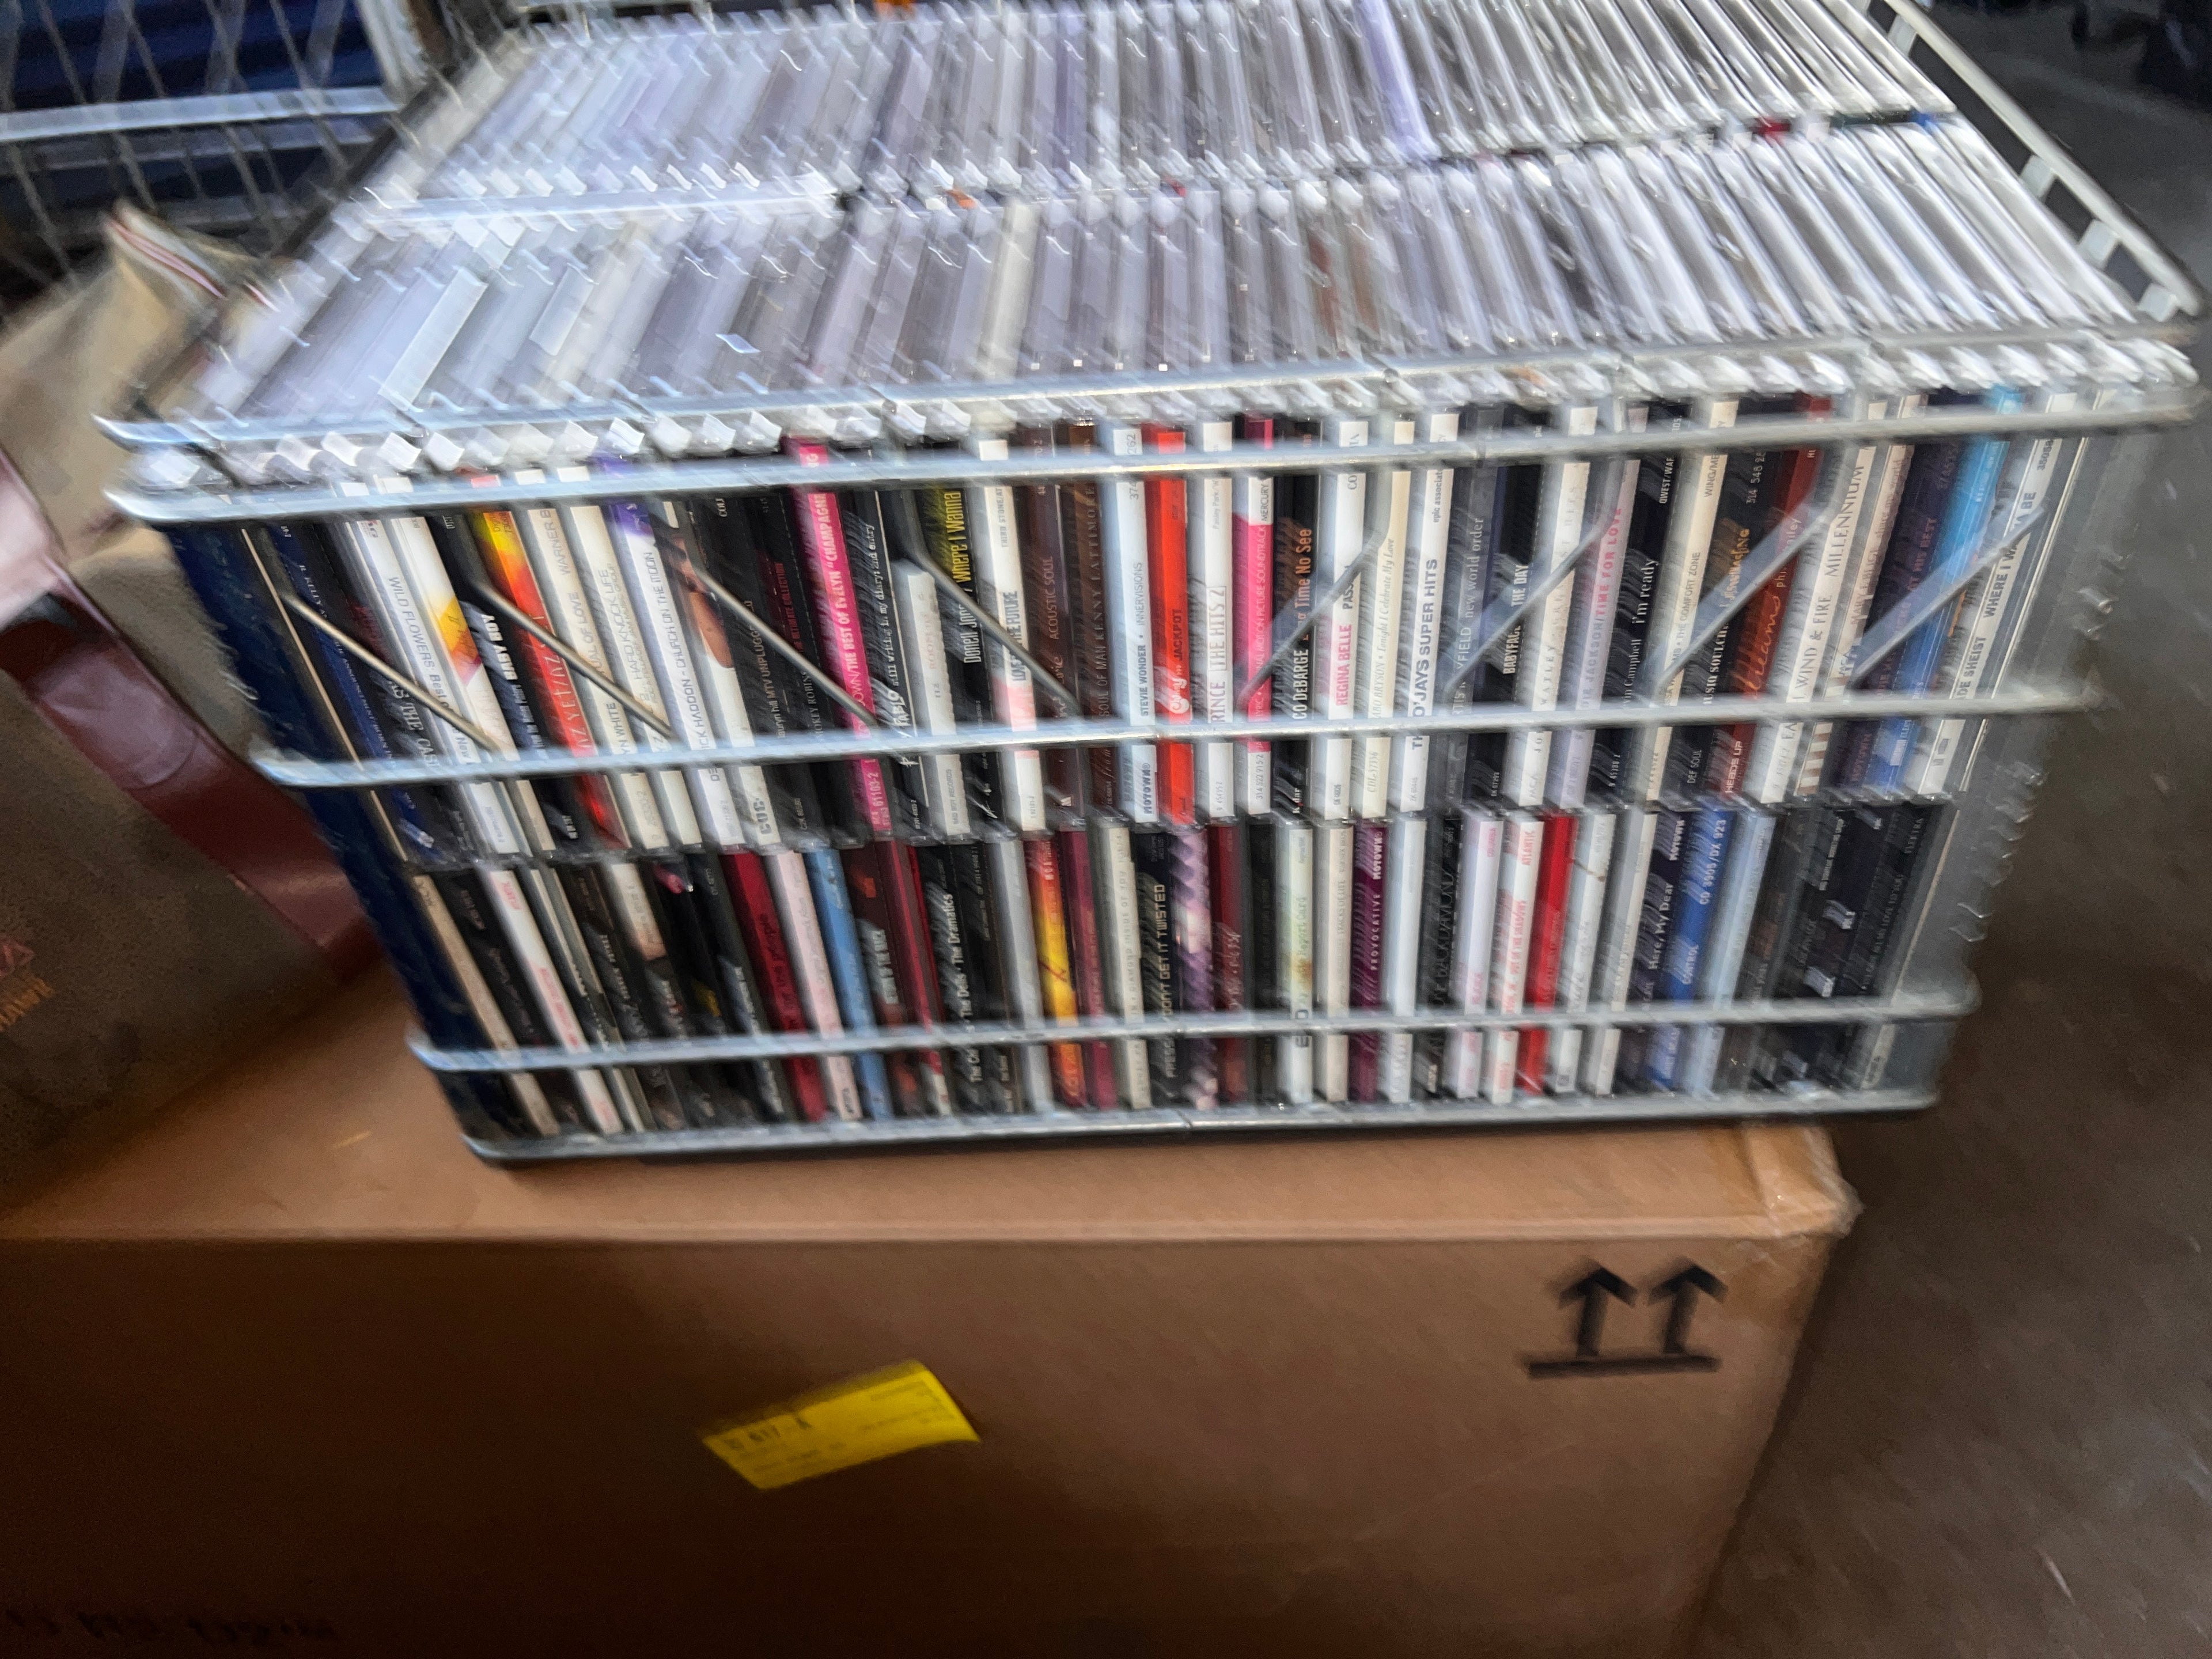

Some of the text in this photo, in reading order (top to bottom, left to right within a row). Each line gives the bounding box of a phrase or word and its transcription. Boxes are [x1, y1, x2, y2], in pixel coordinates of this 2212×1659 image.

[944, 491, 964, 533] Wanna
[1260, 484, 1270, 522] MERCURY
[1432, 507, 1442, 523] epic
[545, 522, 570, 576] WARNER
[865, 524, 877, 550] entry
[1256, 525, 1267, 584] SOUNDTRACK
[1382, 538, 1395, 558] Love
[1601, 508, 1623, 578] FOR LOVE
[643, 552, 662, 584] MOON
[869, 552, 880, 569] 2nd
[951, 544, 971, 582] Where
[1294, 529, 1312, 609] Time No See
[1381, 560, 1395, 574] My
[1423, 559, 1438, 597] HITS
[1463, 517, 1484, 618] new world order
[1513, 565, 1530, 584] DAY
[1685, 552, 1700, 576] ZONE
[1797, 465, 1865, 688] WIND & FIRE MILLENNIUM
[652, 586, 666, 605] THE
[1041, 555, 1060, 639] ACOUSTIC SOUL
[1209, 589, 1224, 597] 2
[1256, 585, 1266, 617] PICTURE
[1378, 575, 1392, 614] Celebrate
[1510, 588, 1527, 607] THE
[1677, 579, 1695, 622] COMFORT
[1964, 636, 1987, 677] SHEIST
[1983, 573, 2009, 618] WHERE
[2020, 491, 2036, 510] BE
[569, 591, 588, 623] LOVE
[598, 569, 643, 680] HARD KNOCK LIFE
[660, 609, 672, 623] ON
[828, 571, 855, 650] BEST OF EVELYN
[877, 603, 888, 614] my
[1002, 591, 1018, 626] FUTURE
[1209, 603, 1225, 637] HITS
[1623, 558, 1659, 687] Campbell i'm ready
[388, 577, 446, 697] WILD Best
[1132, 562, 1150, 717] STEVIE WONDER INNERVISIONS
[1172, 609, 1183, 661] JACKPOT
[1255, 618, 1266, 652] MOTION
[1376, 622, 1389, 652] Tonight
[1419, 602, 1434, 655] SUPER
[482, 615, 518, 680] BABY BOY
[664, 626, 687, 668] CHURCH
[960, 631, 982, 663] Donell
[1094, 645, 1108, 670] MAN
[1209, 641, 1226, 667] THE
[1335, 624, 1353, 706] REGINA BELLE
[764, 680, 778, 699] MTV
[1095, 674, 1108, 687] OF
[1373, 662, 1385, 698] BRYSON
[1540, 645, 1555, 706] WATLEY
[400, 703, 423, 730] THE
[1733, 740, 1743, 755] UP
[945, 769, 955, 797] RECORDS
[1687, 749, 1702, 783] DEF SOUL
[1521, 830, 1535, 866] ATLANTIC
[1699, 892, 1711, 905] CD
[1709, 819, 1726, 839] 923
[1154, 884, 1168, 938] TWISTED
[1647, 820, 1685, 969] Here, My Dear MOTOWN
[941, 894, 961, 944] Dramatics
[1369, 893, 1381, 971] PROVOCATIVE
[949, 946, 964, 964] The
[1155, 942, 1169, 953] IT
[1156, 956, 1171, 980] GET
